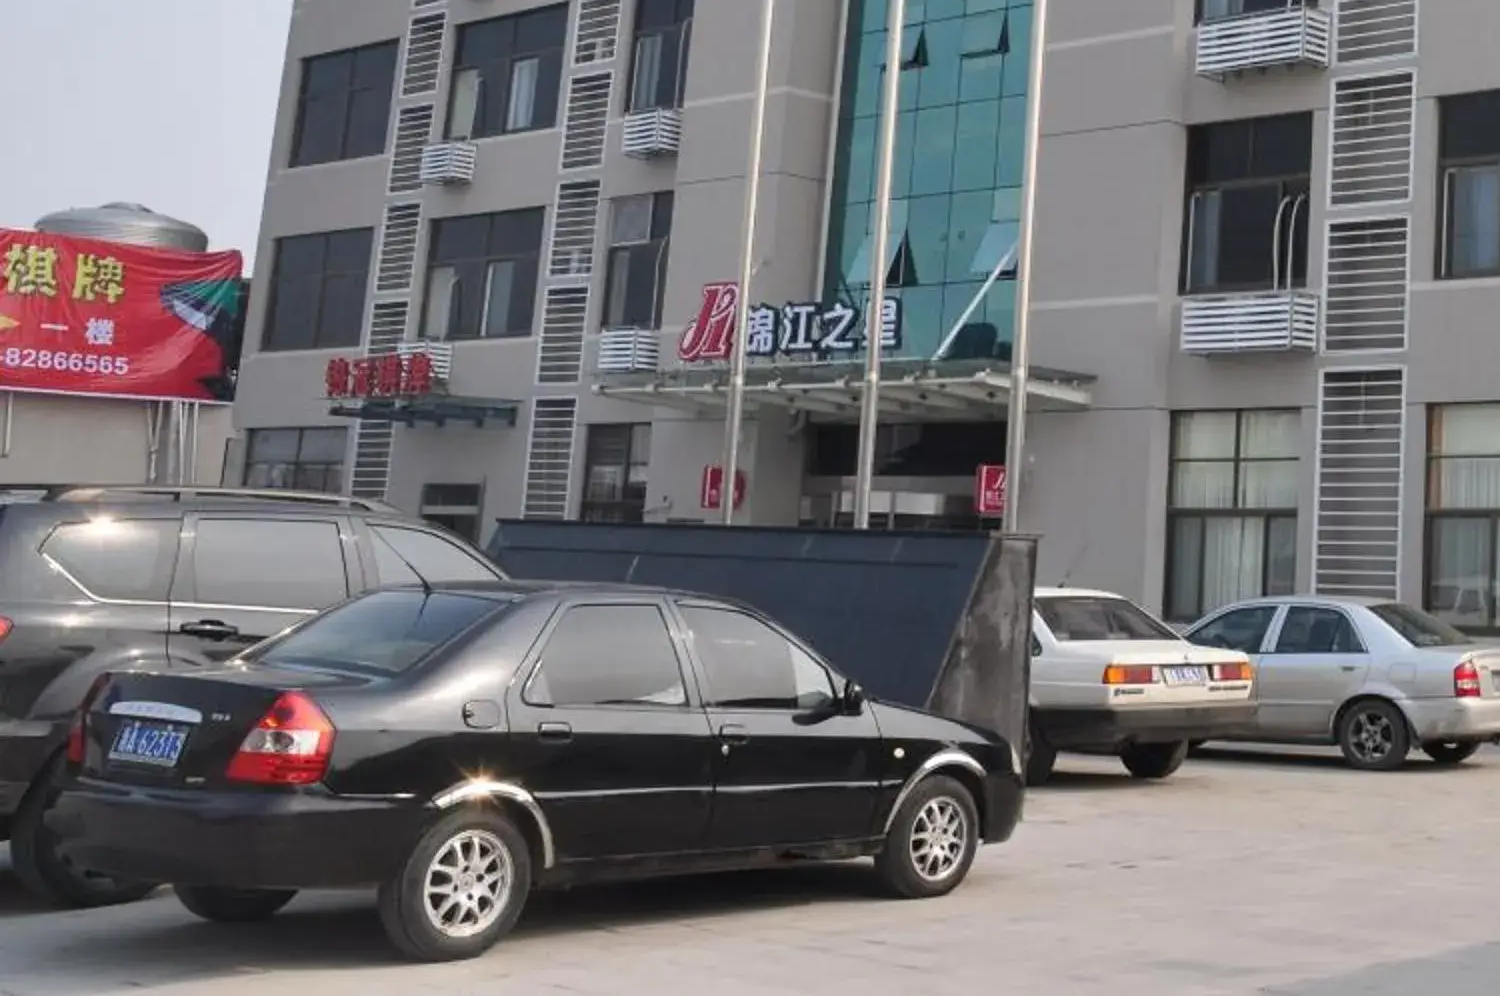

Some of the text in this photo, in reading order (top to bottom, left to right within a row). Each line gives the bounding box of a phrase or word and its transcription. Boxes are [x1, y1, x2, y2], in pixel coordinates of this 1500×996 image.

[4, 243, 126, 304] 棋牌
[746, 298, 898, 354] 锦江之星
